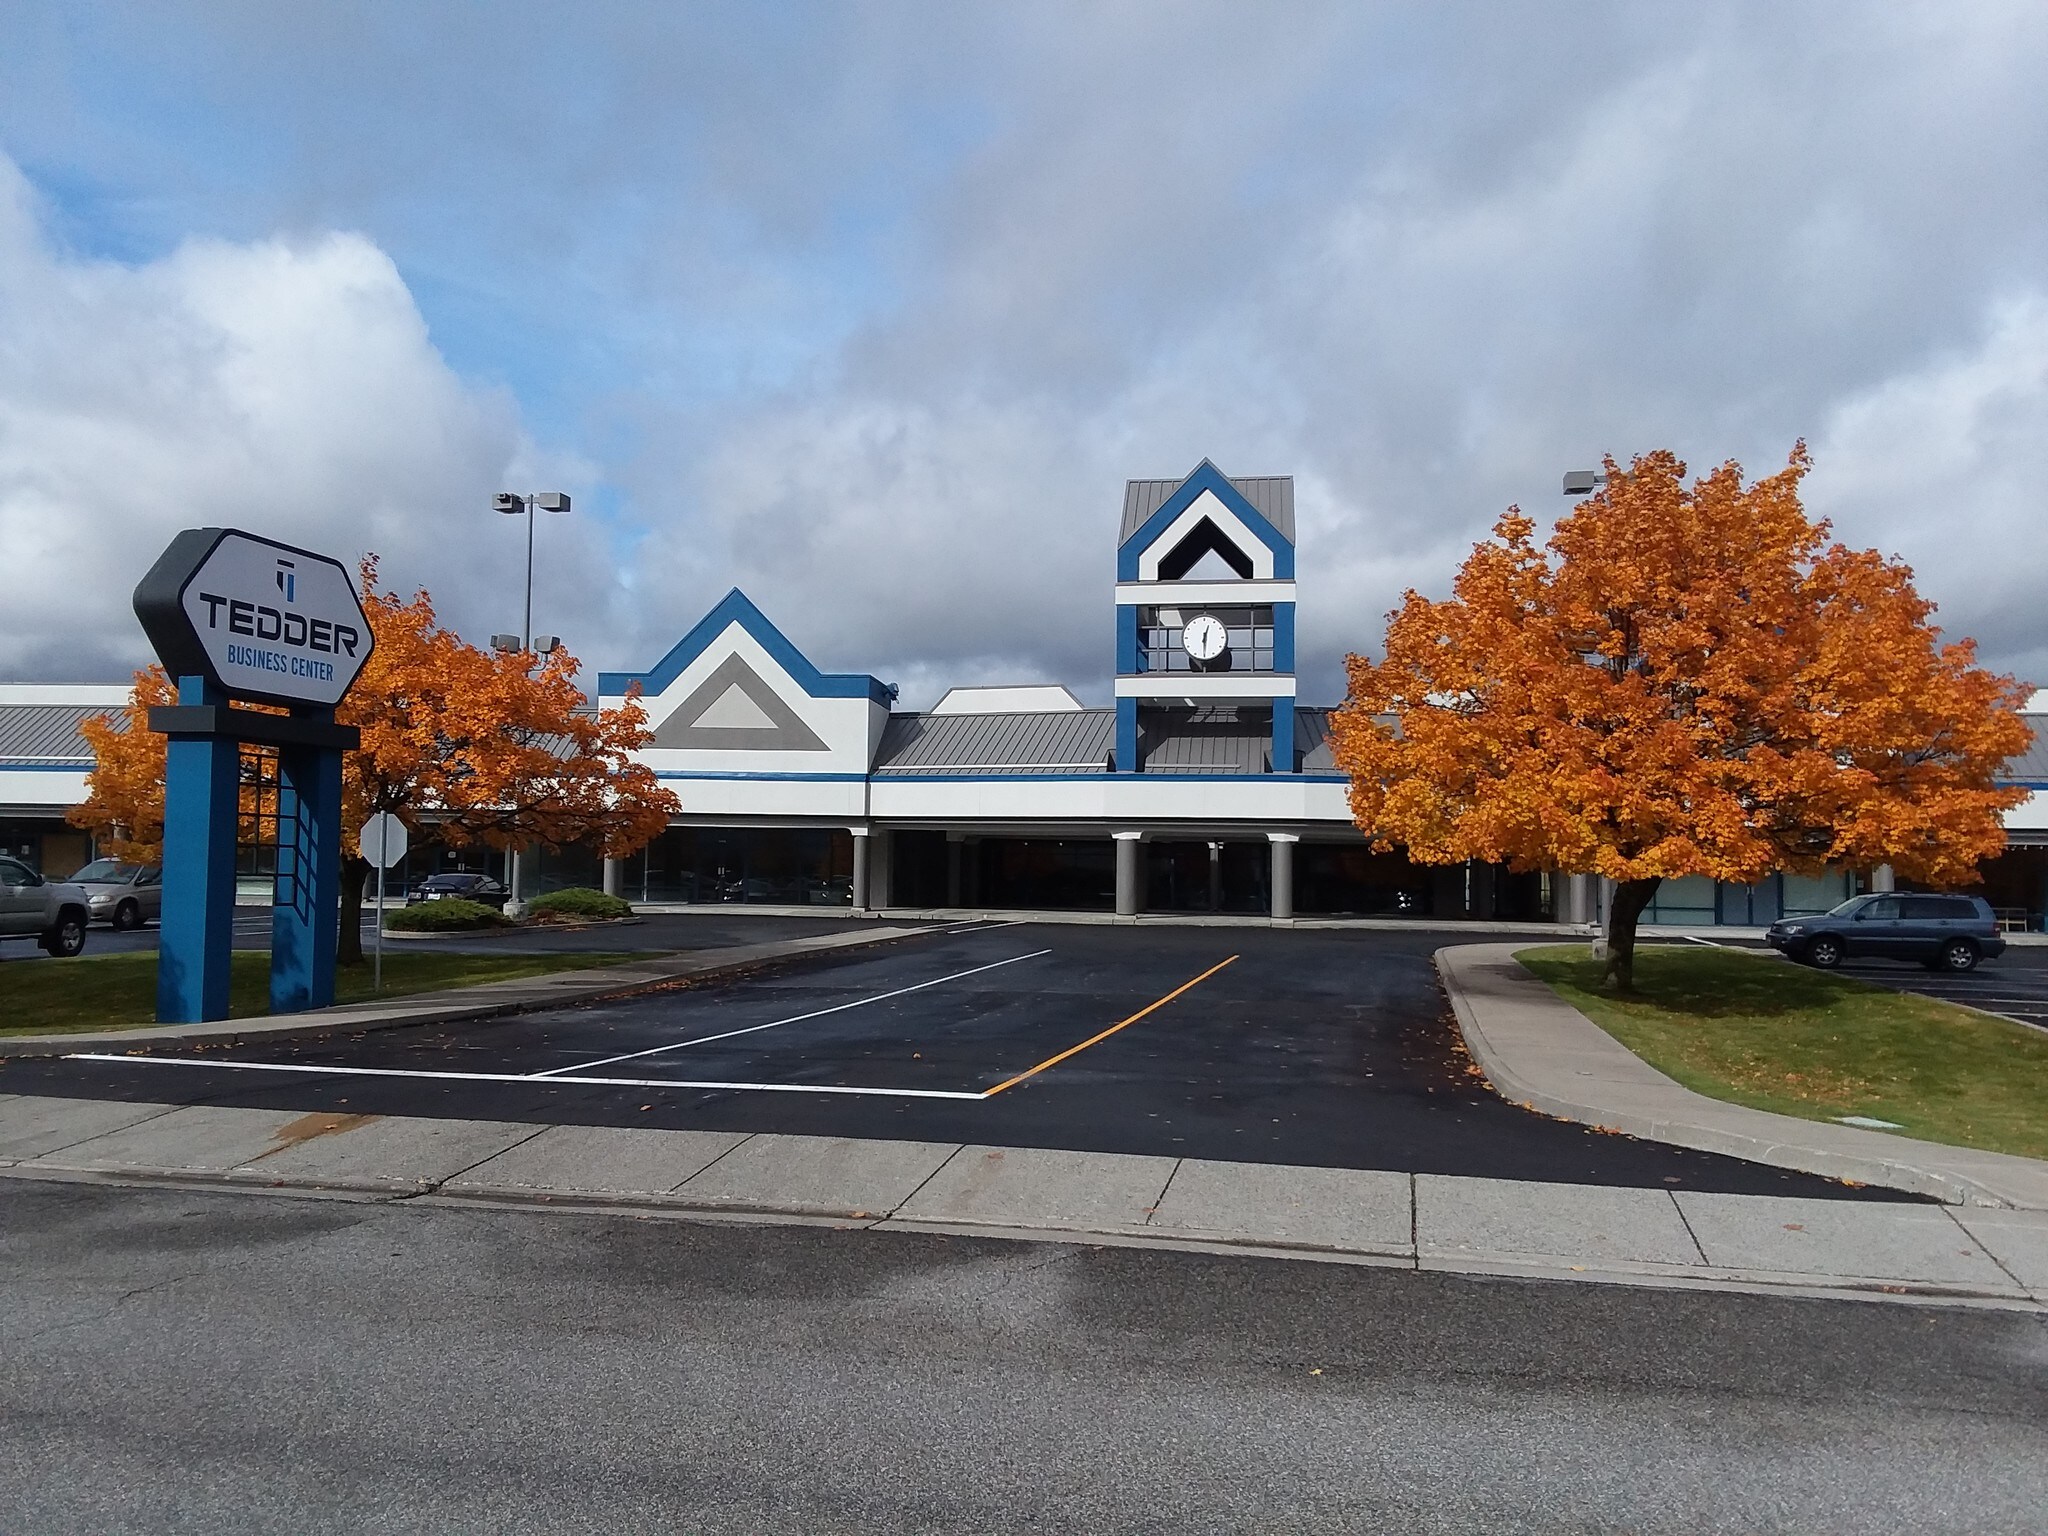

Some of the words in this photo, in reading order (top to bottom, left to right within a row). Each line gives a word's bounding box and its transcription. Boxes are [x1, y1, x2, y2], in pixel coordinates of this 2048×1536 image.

[200, 592, 359, 658] TEDDER
[228, 644, 288, 673] BUSINESS
[291, 657, 334, 682] CENTER
